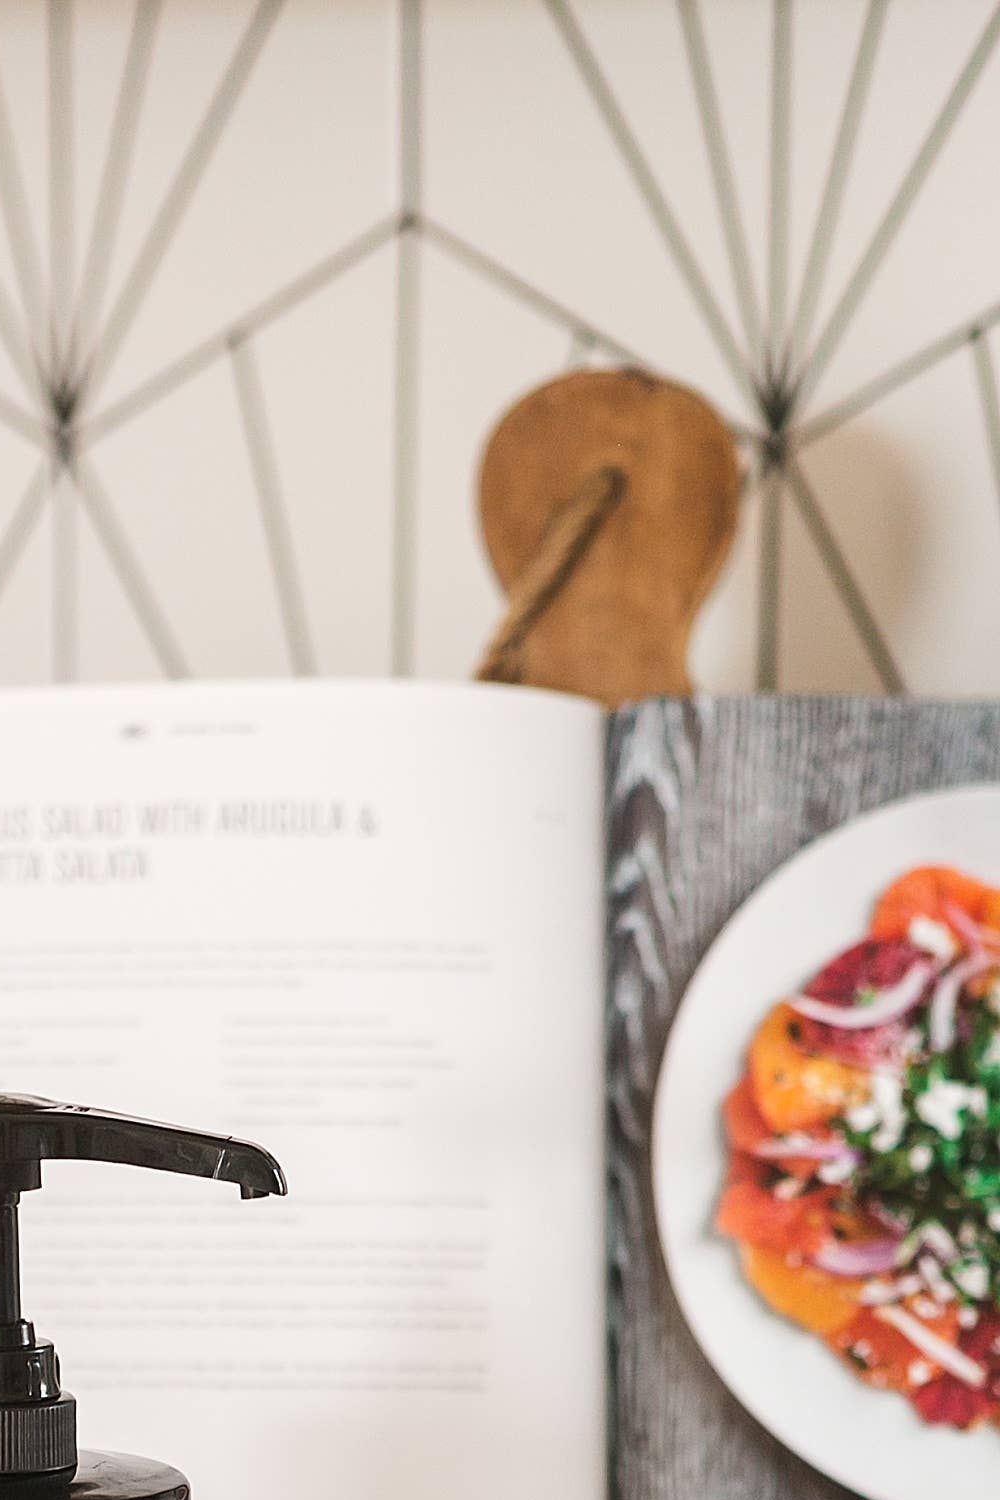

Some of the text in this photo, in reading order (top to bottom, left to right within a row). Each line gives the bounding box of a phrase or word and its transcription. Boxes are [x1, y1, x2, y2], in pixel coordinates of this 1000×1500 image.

[41, 805, 127, 840] SALAD
[138, 803, 206, 837] WITH
[216, 801, 345, 837] ARUGULA
[53, 848, 150, 883] SALATA
